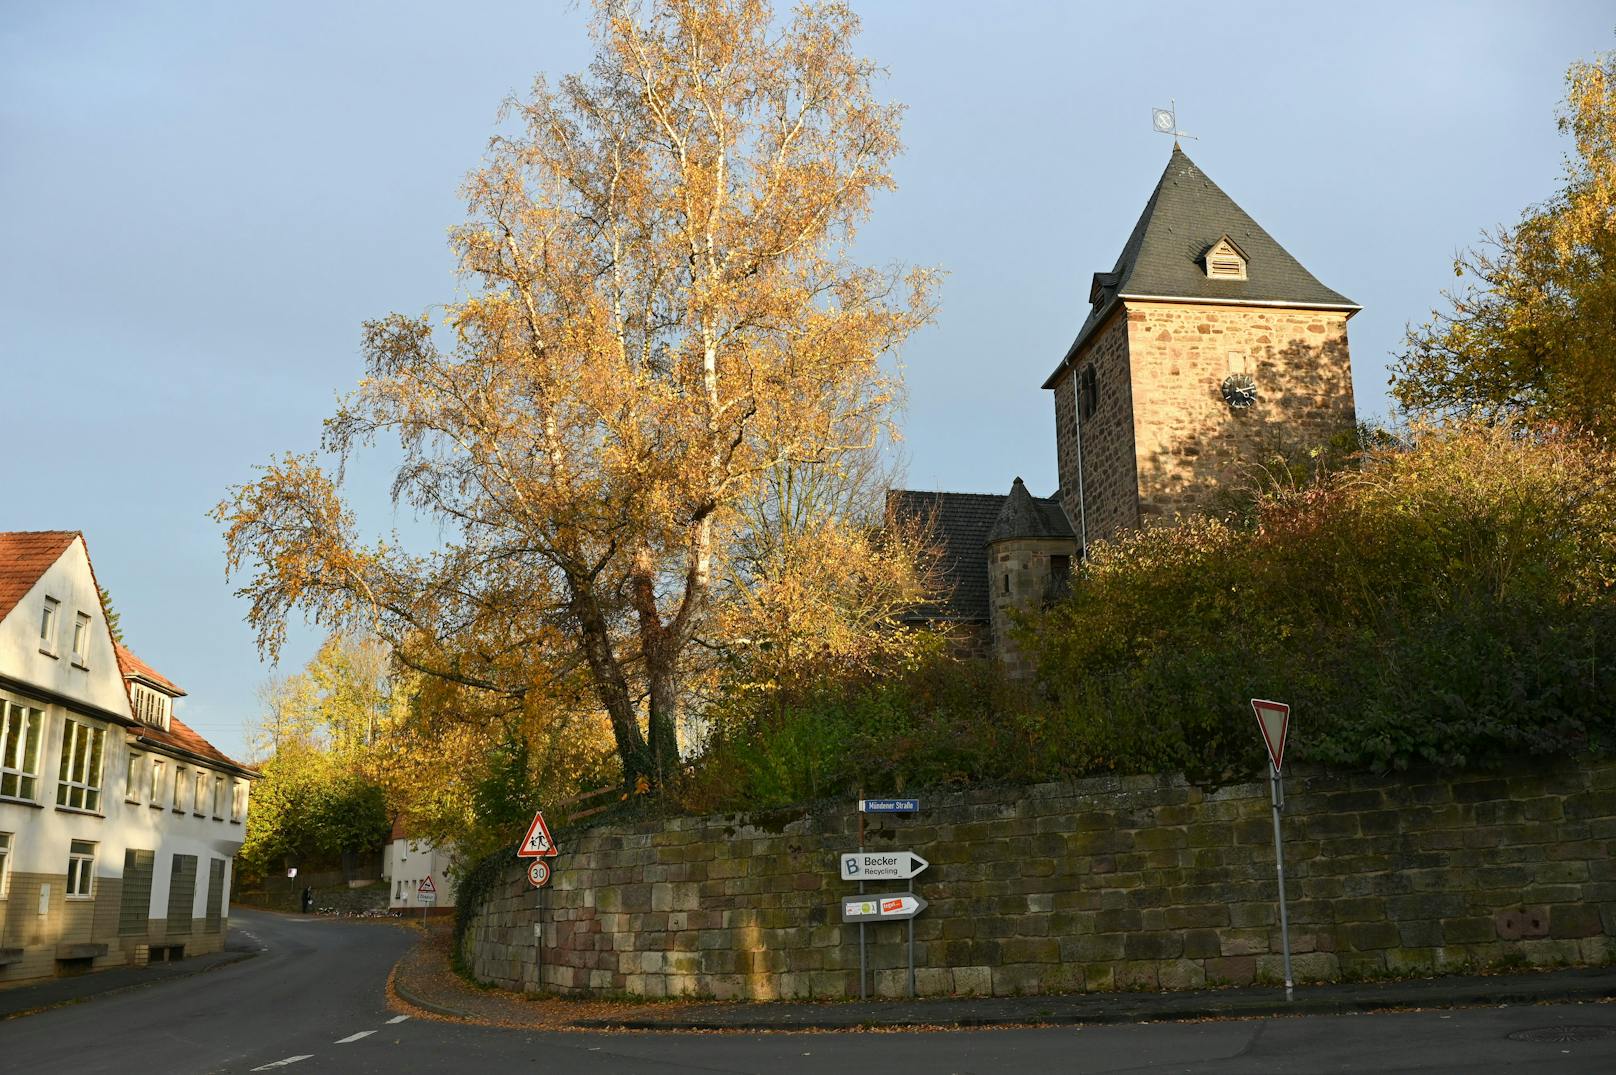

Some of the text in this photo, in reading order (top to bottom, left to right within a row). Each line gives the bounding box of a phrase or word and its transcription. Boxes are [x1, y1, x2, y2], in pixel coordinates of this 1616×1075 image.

[895, 801, 914, 810] Straße
[845, 857, 860, 875] B
[864, 856, 898, 866] Becker
[532, 868, 545, 879] 30
[864, 868, 898, 876] Recycling
